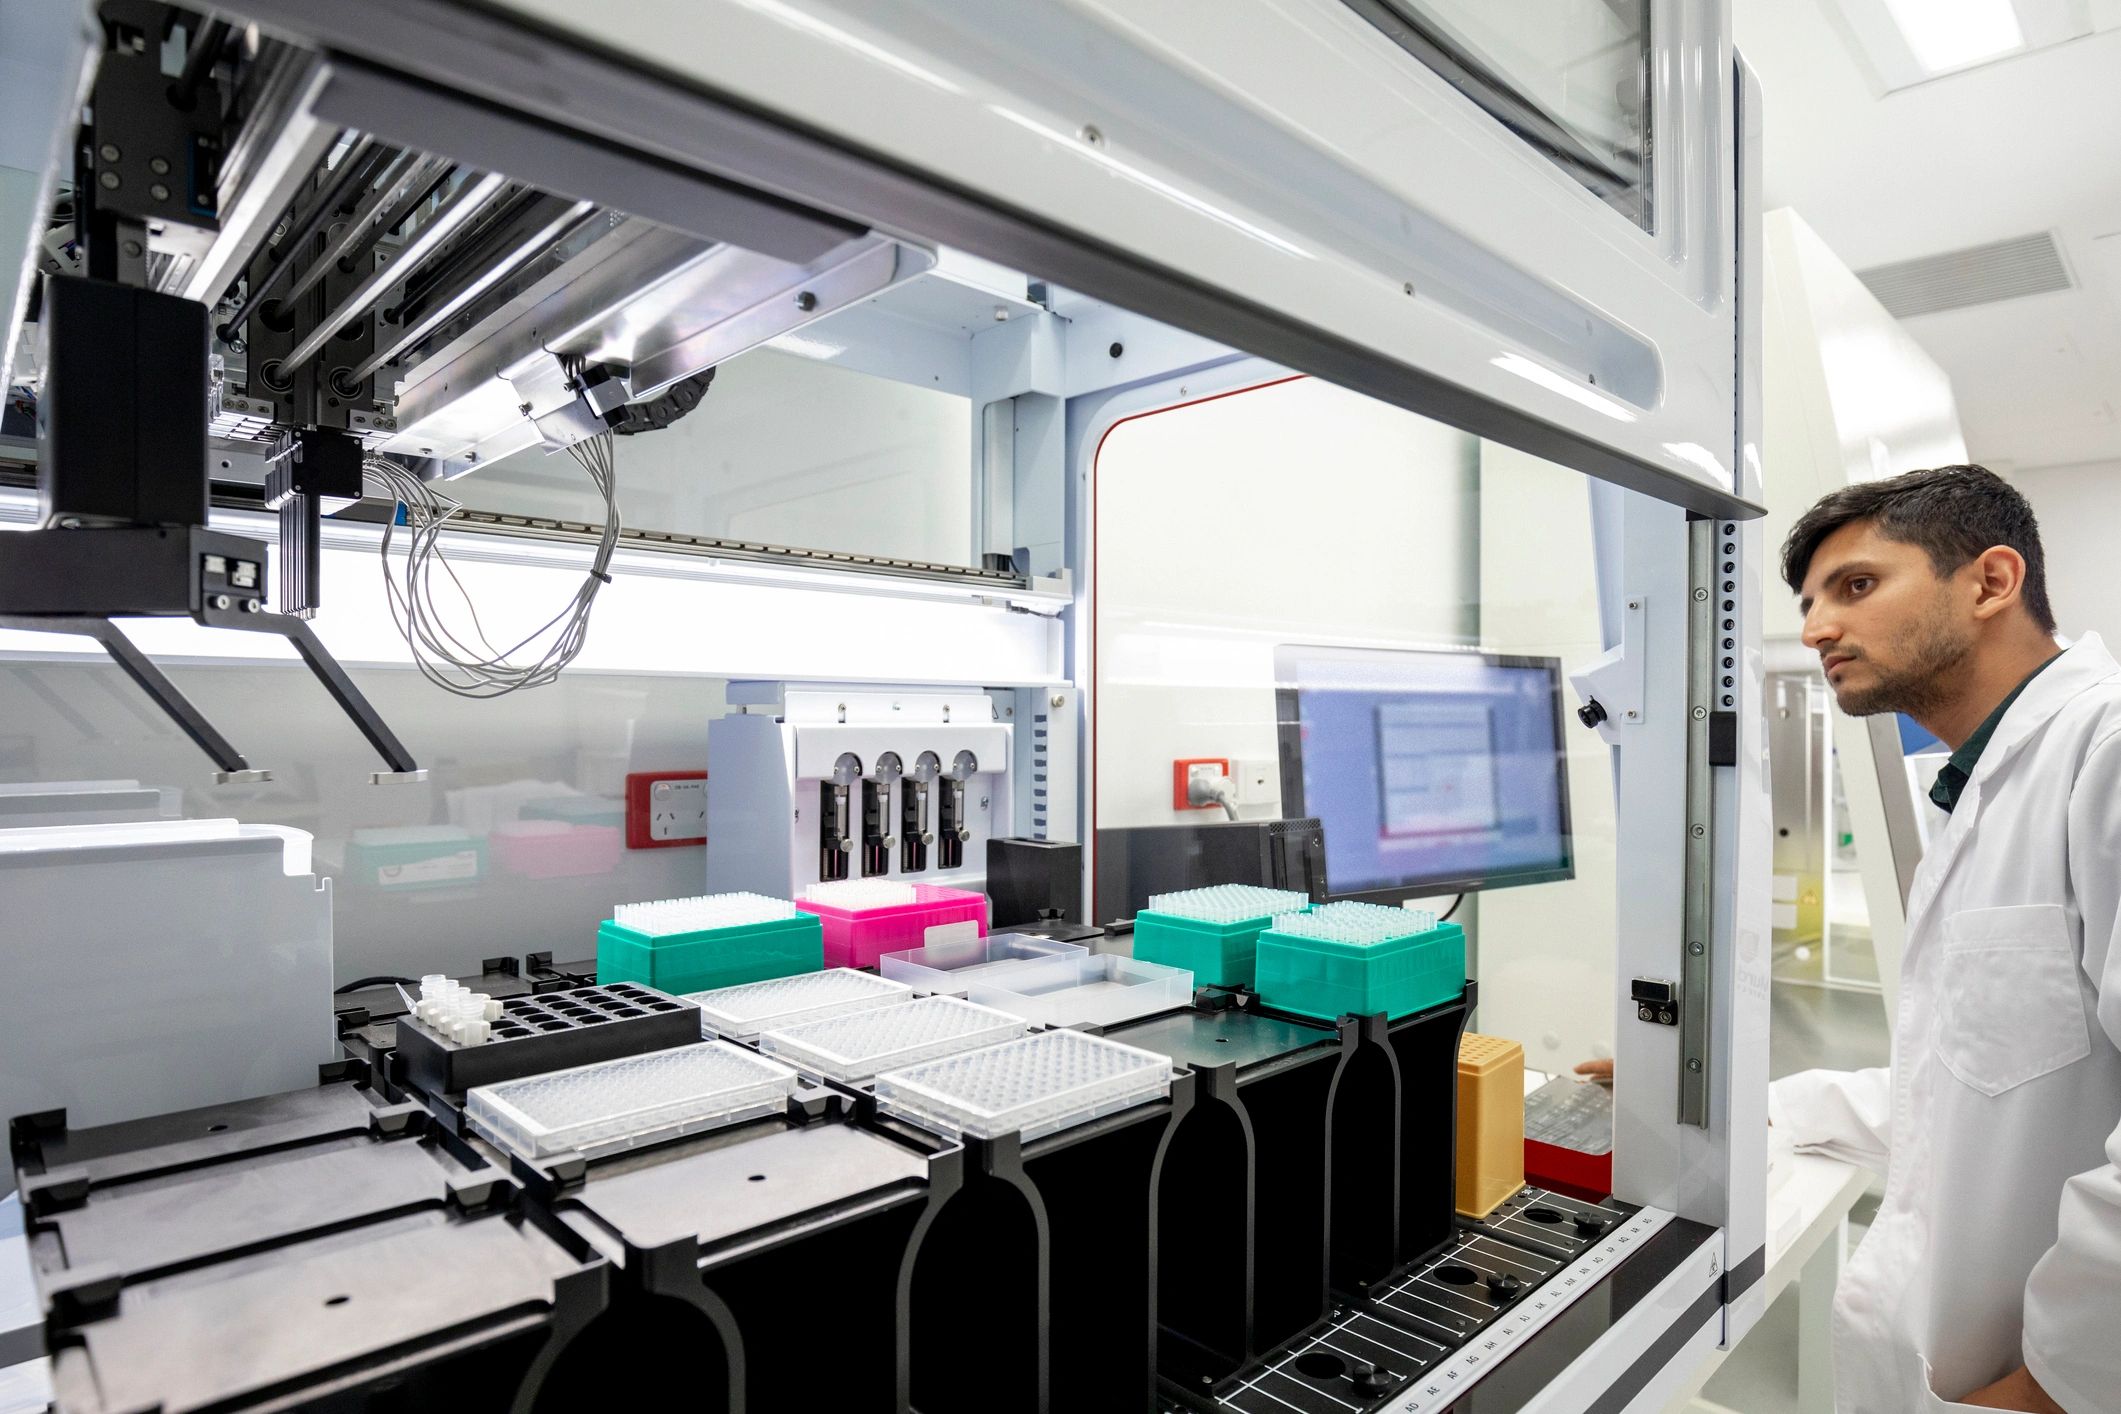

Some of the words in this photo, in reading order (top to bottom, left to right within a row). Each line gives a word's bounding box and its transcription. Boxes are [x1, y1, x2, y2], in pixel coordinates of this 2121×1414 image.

[1405, 1403, 1419, 1412] AD
[1427, 1386, 1440, 1395] AE
[1447, 1370, 1459, 1379] AF
[1466, 1355, 1479, 1365] AG
[1484, 1341, 1498, 1350] AH
[1503, 1328, 1514, 1336] AI
[1520, 1314, 1530, 1322] AJ
